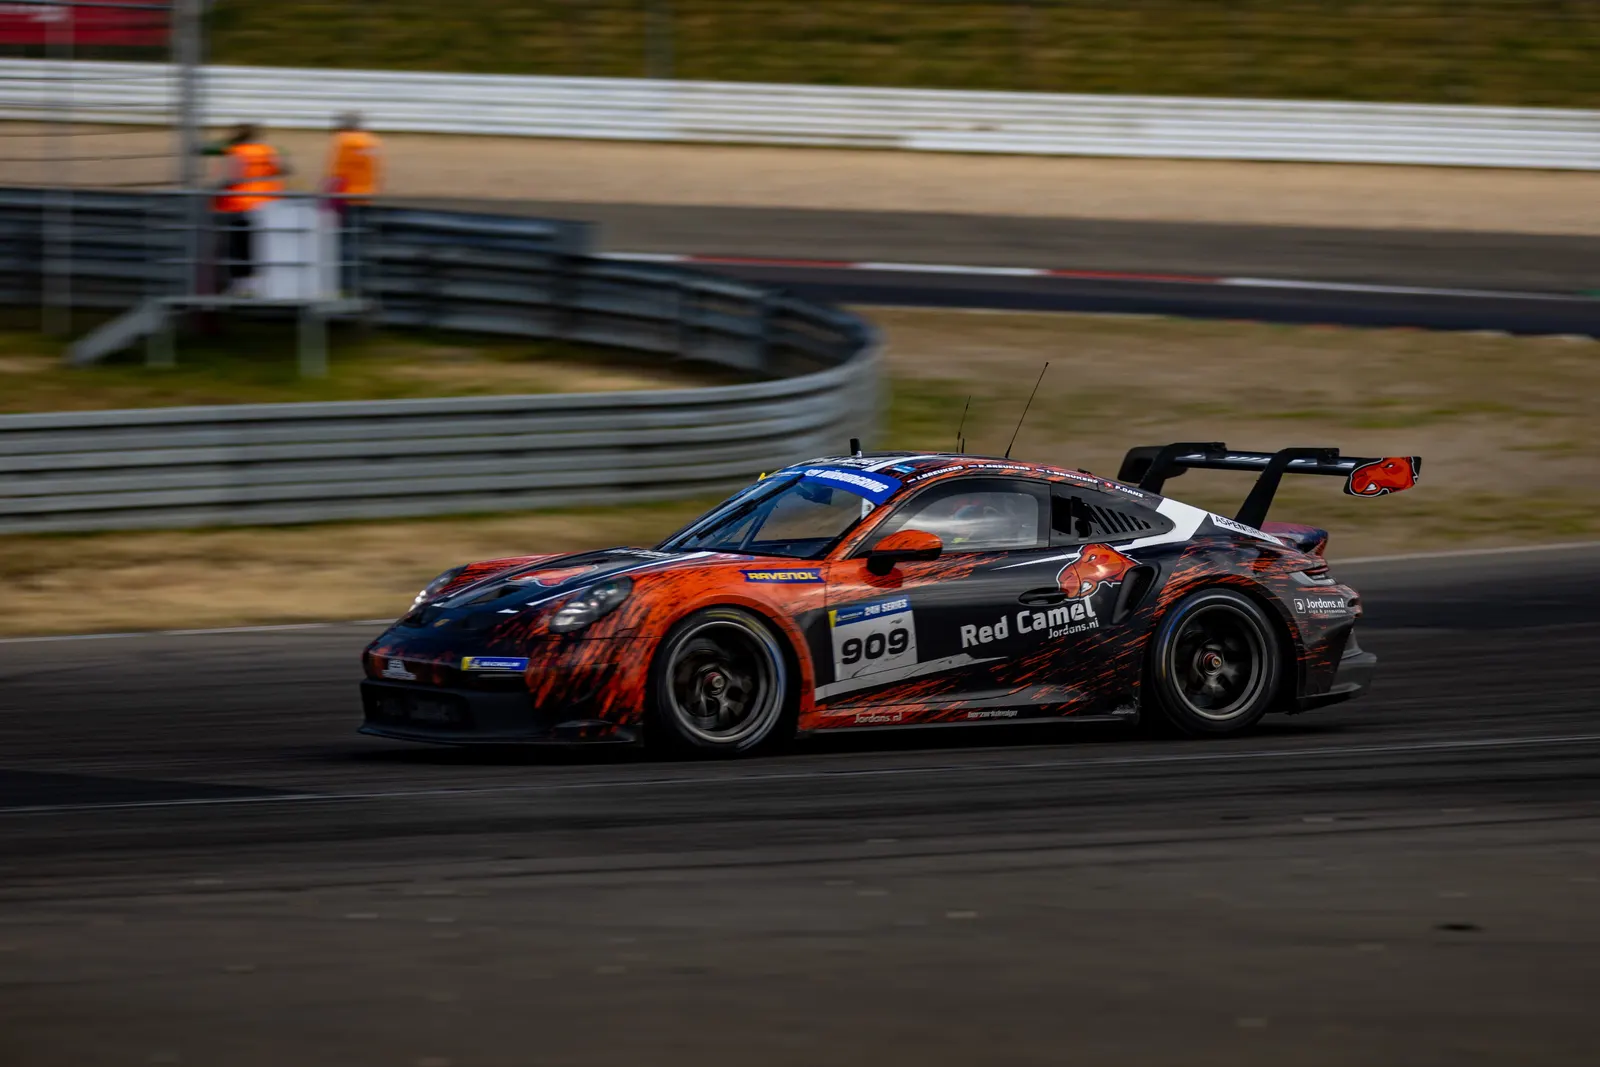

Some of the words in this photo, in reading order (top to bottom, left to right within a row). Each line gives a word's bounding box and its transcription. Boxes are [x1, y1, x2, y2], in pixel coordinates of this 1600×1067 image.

[747, 572, 818, 580] RAVENOL
[960, 615, 1009, 648] Red
[1017, 594, 1096, 634] Camel
[841, 628, 909, 665] 909
